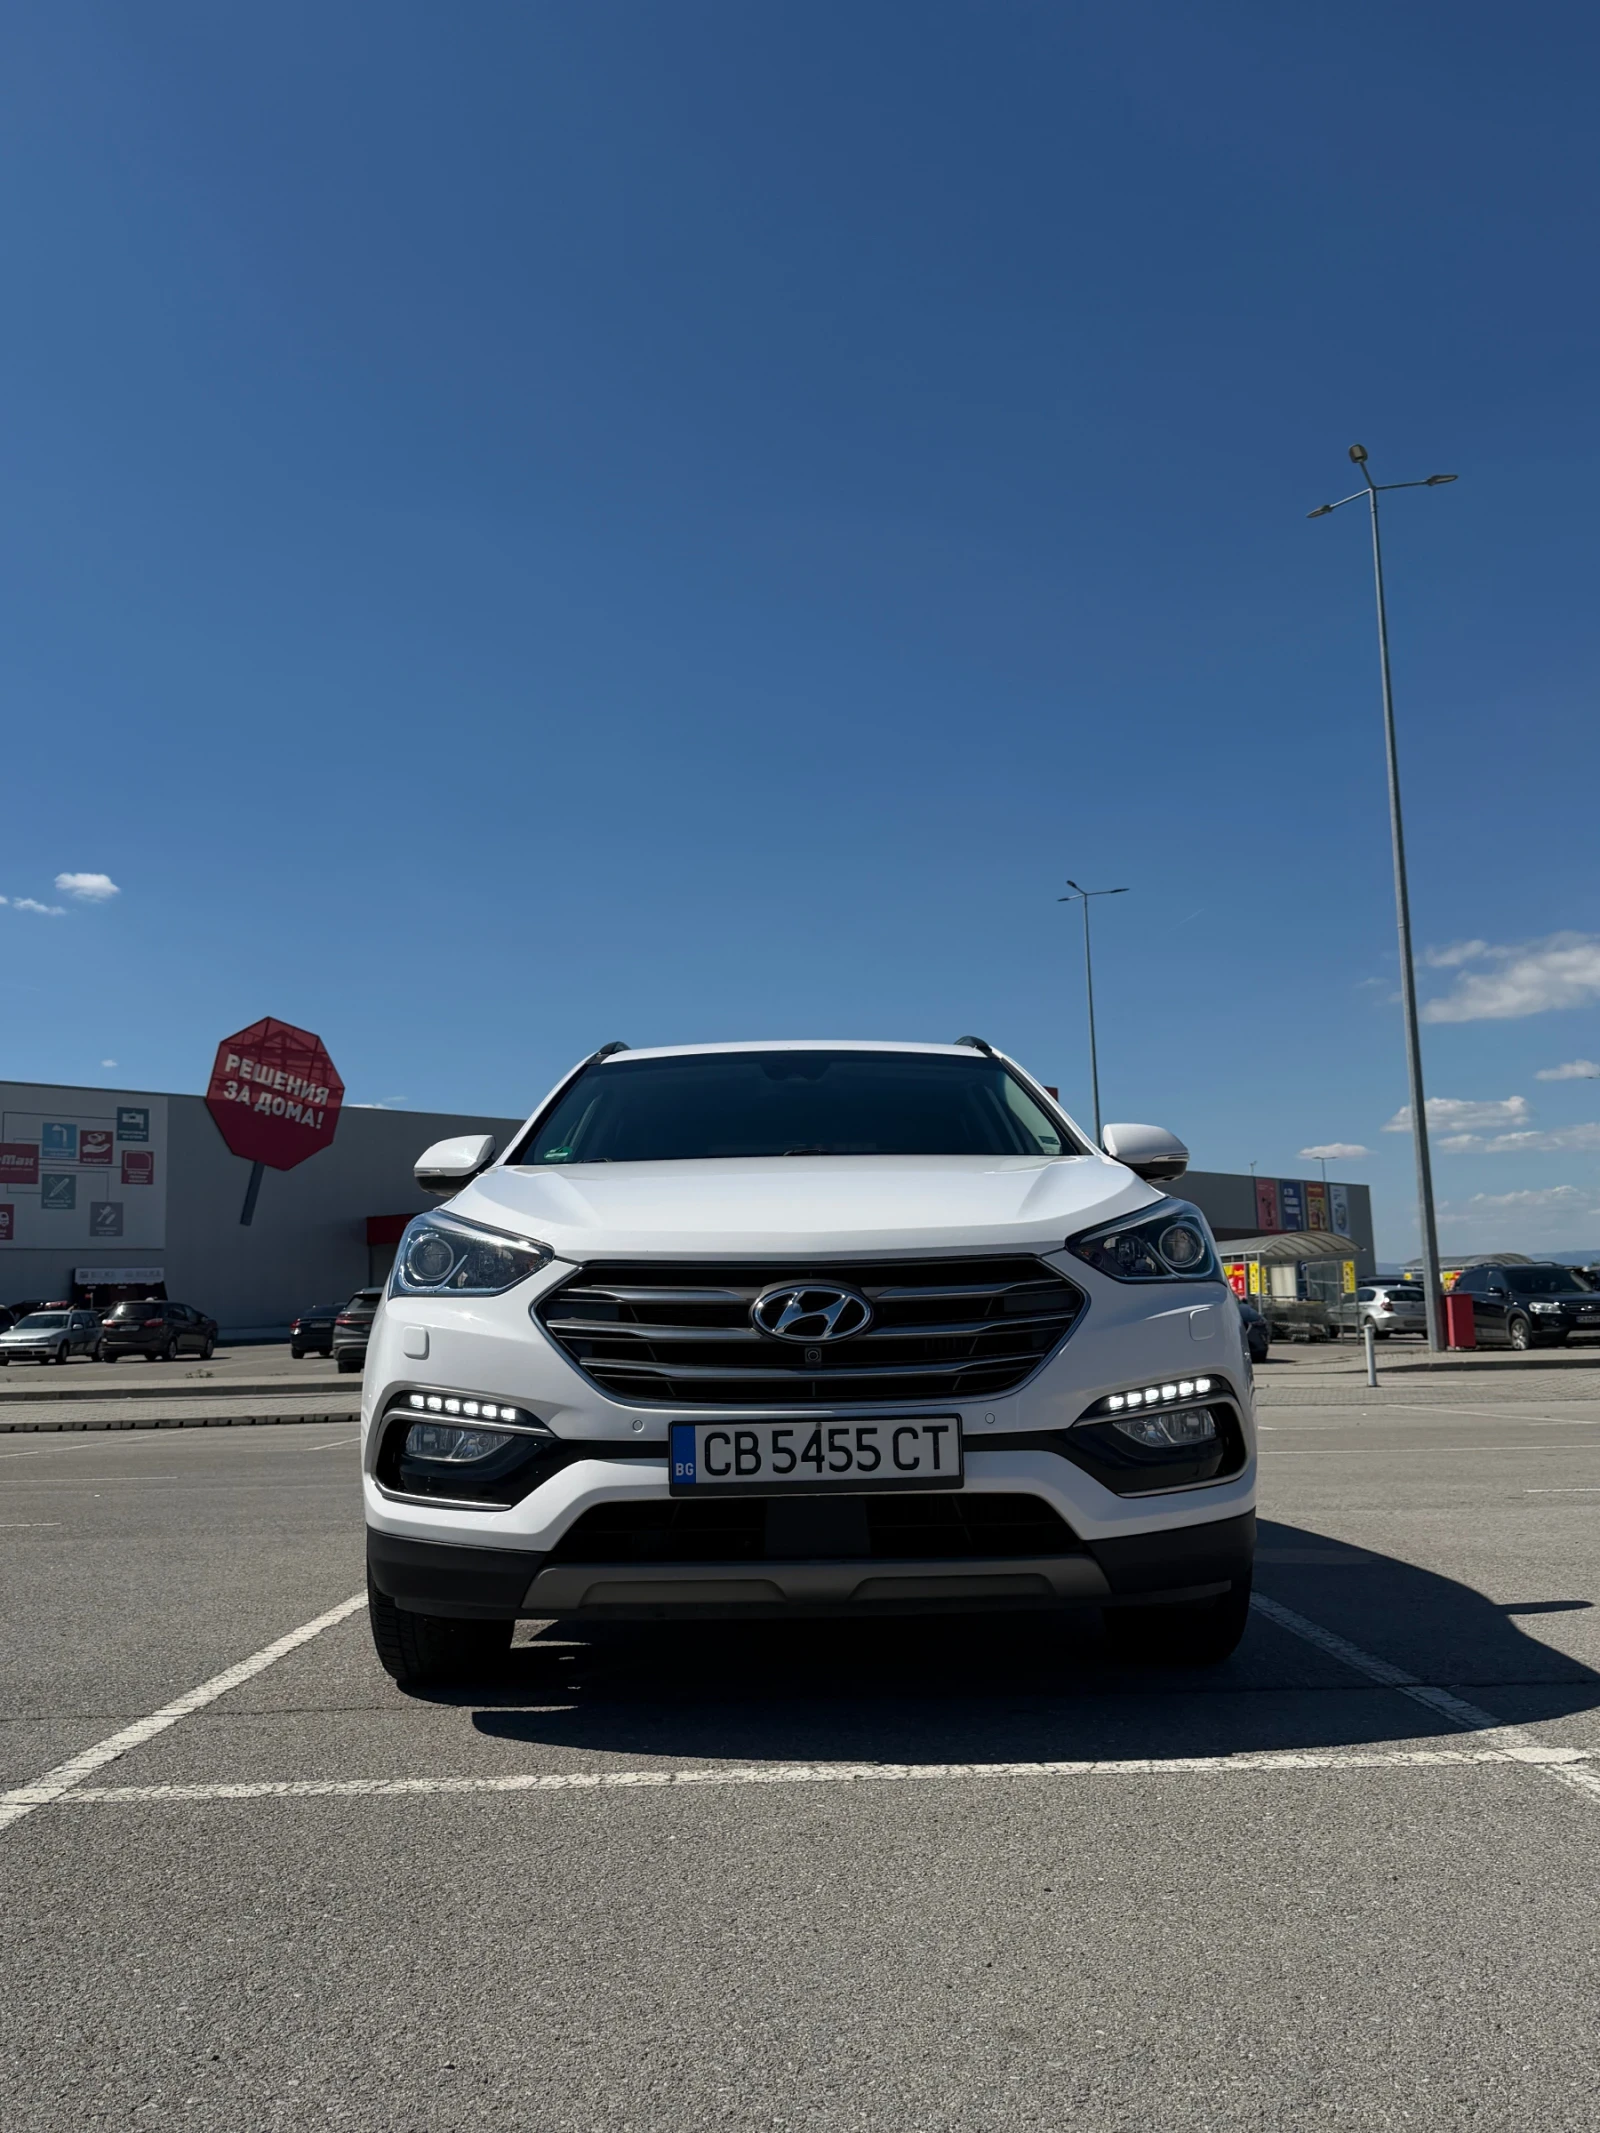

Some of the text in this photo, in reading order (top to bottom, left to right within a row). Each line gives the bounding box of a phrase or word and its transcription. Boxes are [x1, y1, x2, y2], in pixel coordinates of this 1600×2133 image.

[224, 1053, 330, 1106] РЕШЕНИЯ
[223, 1080, 325, 1130] ЗА ДОМА!
[675, 1462, 694, 1477] BG
[772, 1427, 882, 1474] 5455
